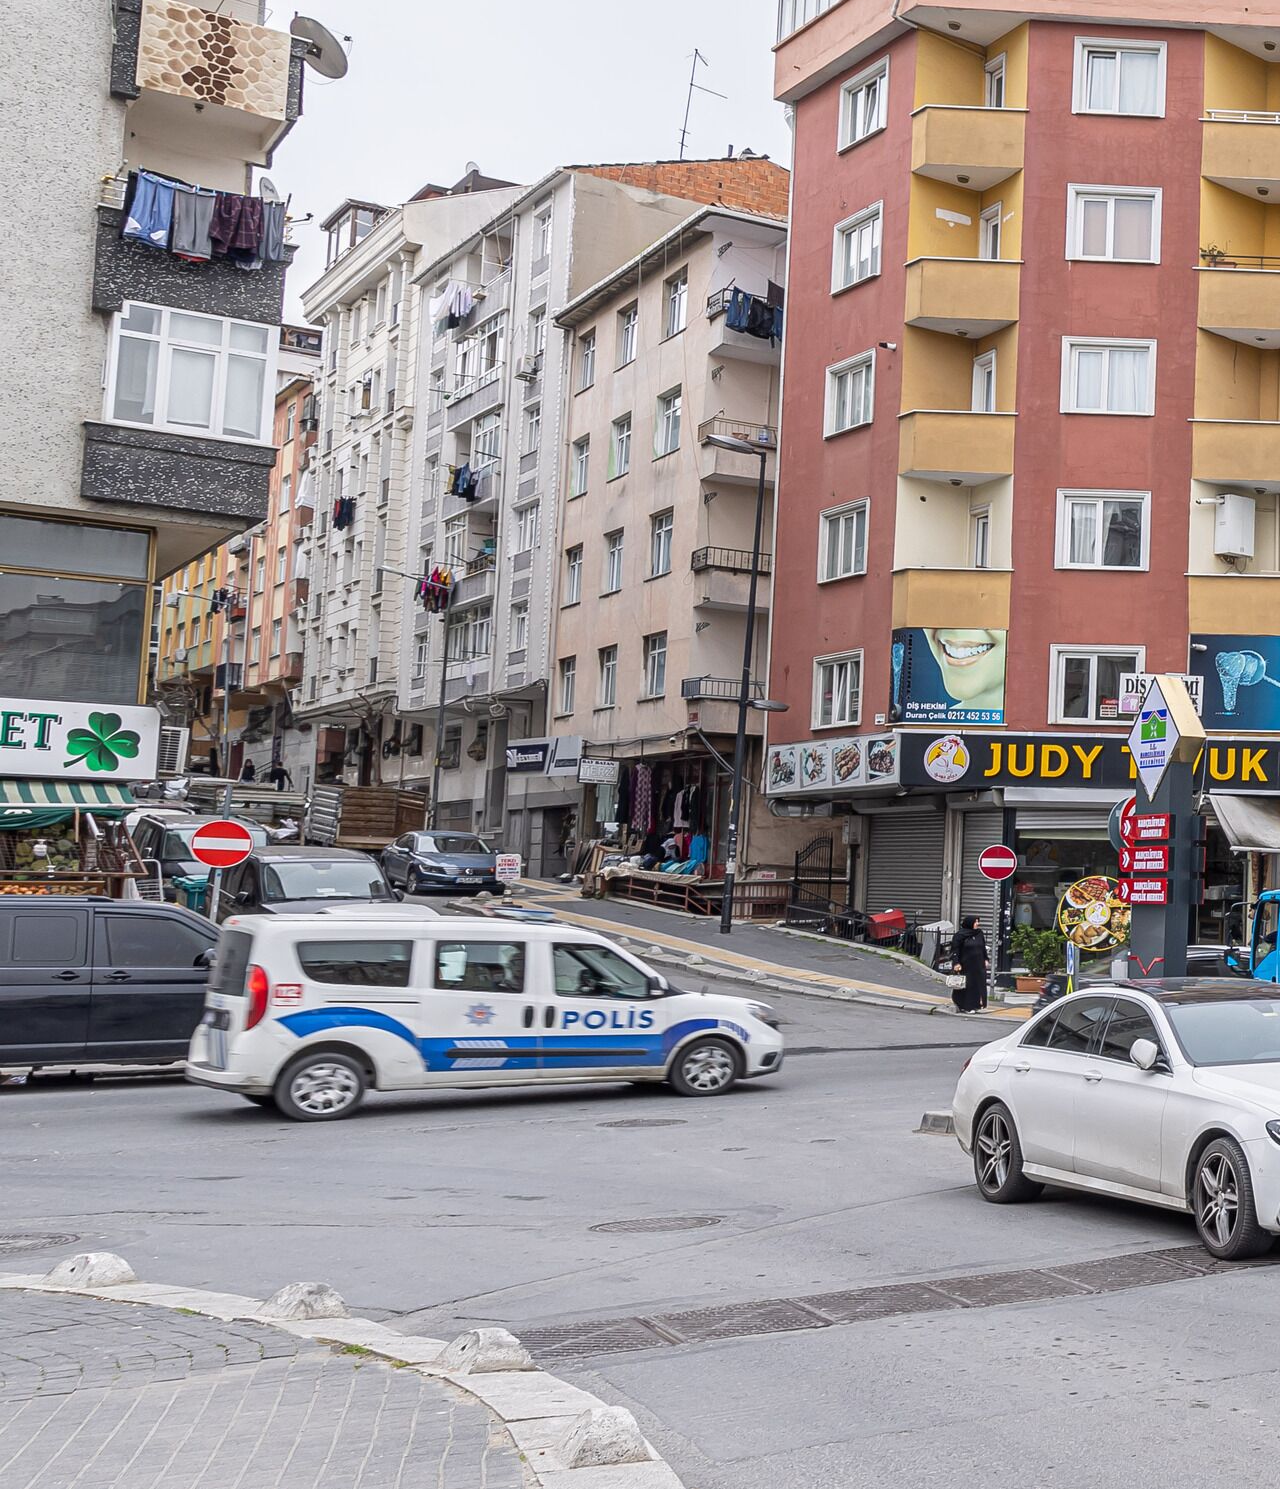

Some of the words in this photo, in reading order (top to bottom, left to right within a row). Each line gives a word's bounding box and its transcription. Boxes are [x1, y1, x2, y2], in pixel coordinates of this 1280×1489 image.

[1125, 675, 1147, 695] DİŞ
[906, 701, 920, 711] DİŞ
[920, 702, 947, 710] HEKİMİ
[928, 712, 946, 720] Çelik
[947, 711, 965, 720] 0212
[966, 711, 980, 720] 452
[981, 712, 990, 720] 53
[992, 713, 1001, 721] 56
[984, 743, 1103, 778] JUDY
[1121, 745, 1269, 782] TUK
[560, 1005, 655, 1030] POLİS
